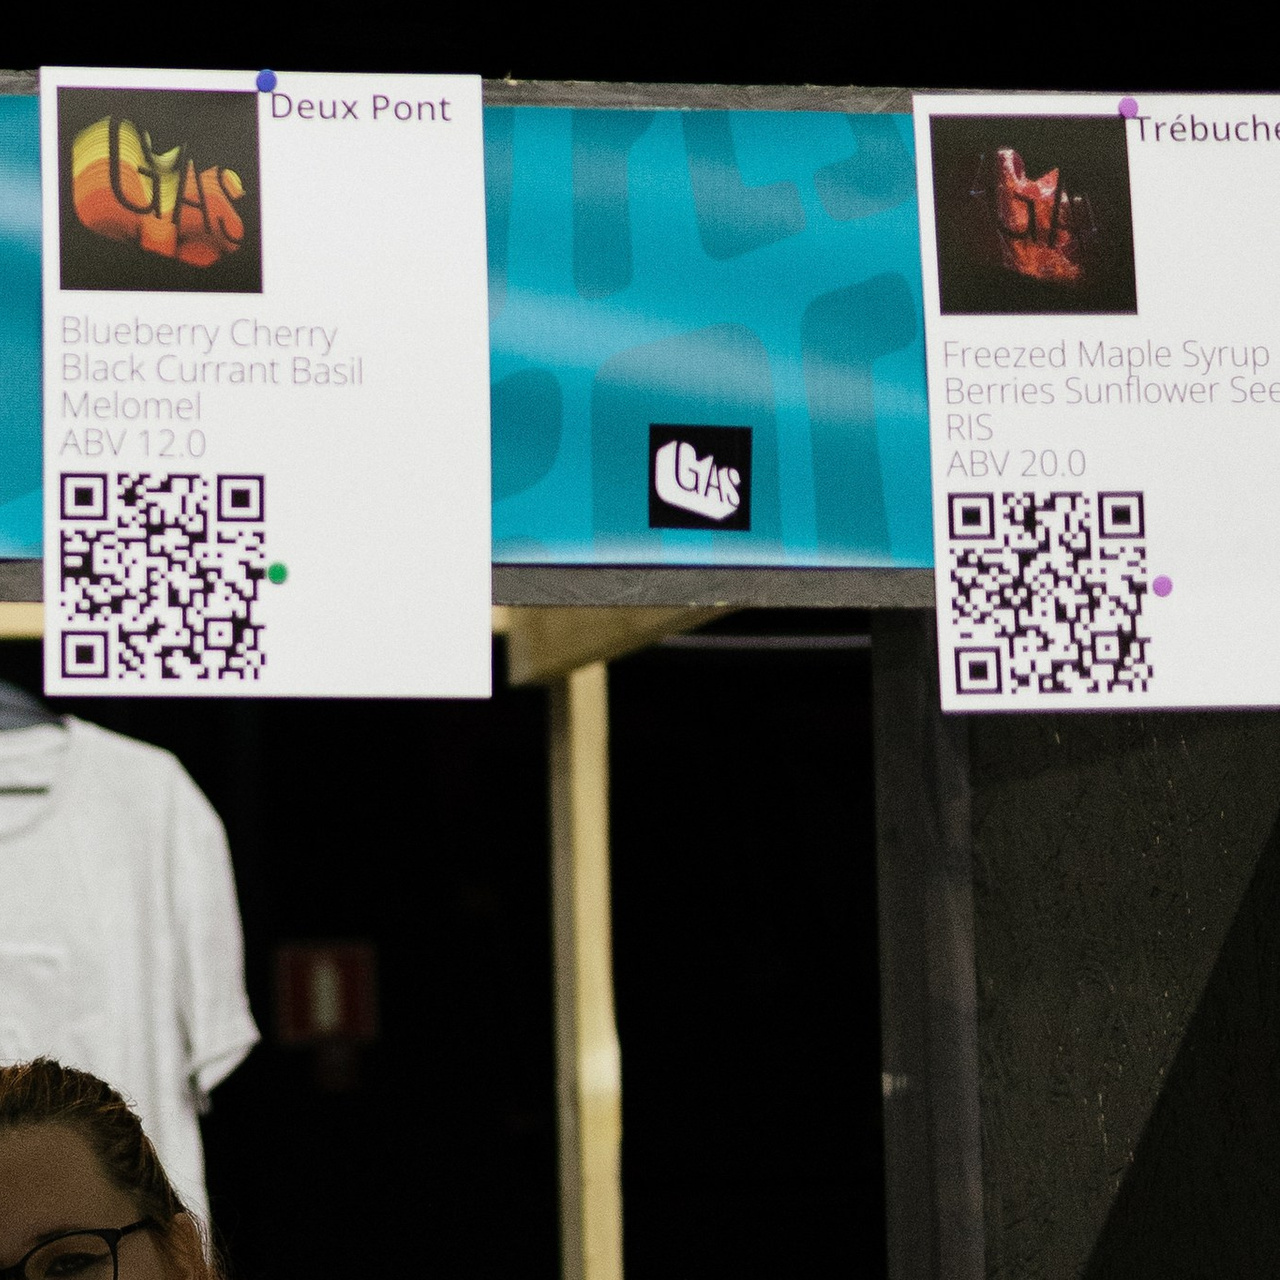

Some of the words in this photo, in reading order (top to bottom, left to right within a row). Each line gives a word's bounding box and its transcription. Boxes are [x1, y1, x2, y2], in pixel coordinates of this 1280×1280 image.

[271, 93, 359, 120] Deux
[372, 94, 452, 122] Pont
[61, 315, 220, 354] Blueberry
[229, 318, 338, 356] Cherry
[62, 352, 145, 383] Black
[155, 354, 279, 385] Currant
[292, 356, 363, 386] Basil
[943, 339, 1067, 368] Freezed
[1078, 339, 1172, 376] Maple
[1182, 339, 1270, 376] Syrup
[62, 390, 201, 420] Melomel
[945, 376, 1055, 405] Berries
[1065, 375, 1220, 405] Sunflower
[946, 412, 994, 441] RIS
[59, 427, 127, 457] ABV
[139, 428, 207, 458] 12.0
[946, 449, 1010, 477] ABV
[1020, 448, 1086, 477] 20.0
[655, 440, 741, 520] GAS
